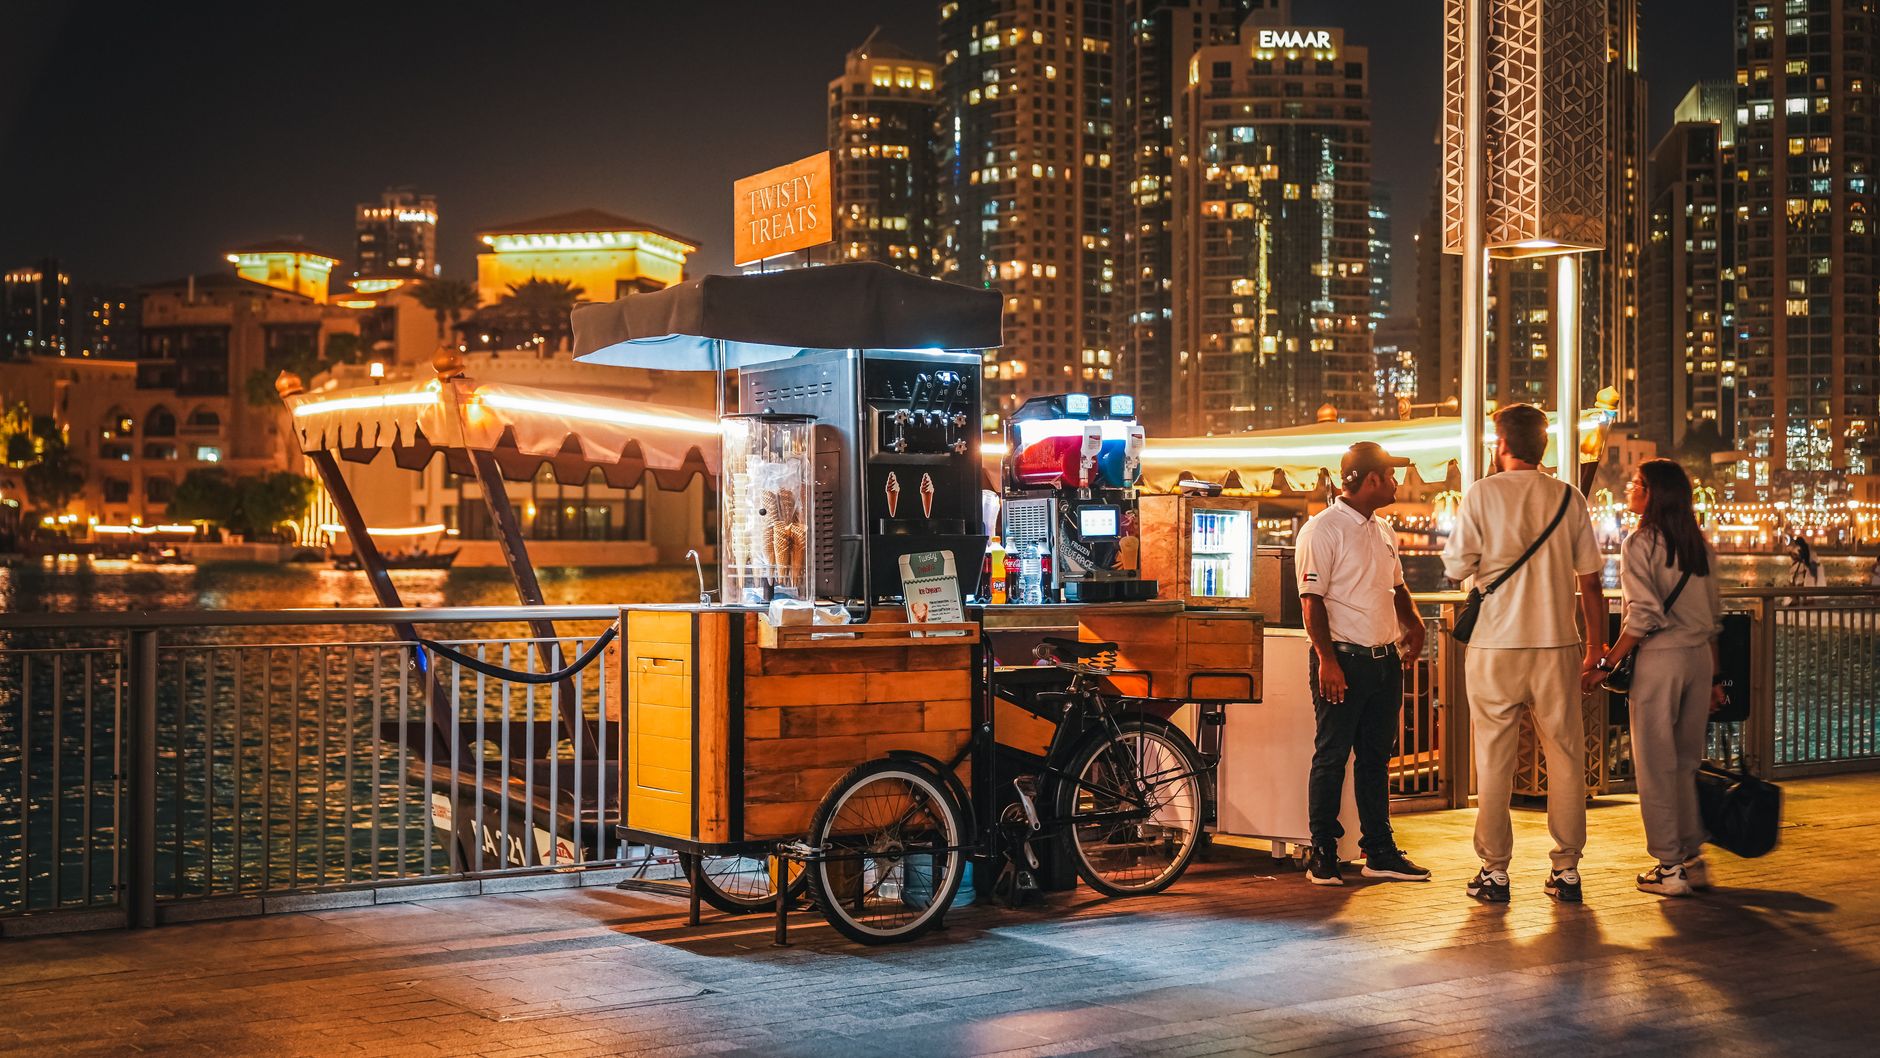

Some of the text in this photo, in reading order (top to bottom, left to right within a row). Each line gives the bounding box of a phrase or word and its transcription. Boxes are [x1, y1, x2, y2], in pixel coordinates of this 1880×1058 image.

[1260, 30, 1331, 48] EMAAR
[748, 173, 815, 215] TWISTY
[749, 204, 817, 245] TREATS
[1059, 544, 1094, 569] BEVERAGE
[1070, 540, 1090, 556] FROZEN
[1004, 558, 1020, 568] Coca-Co
